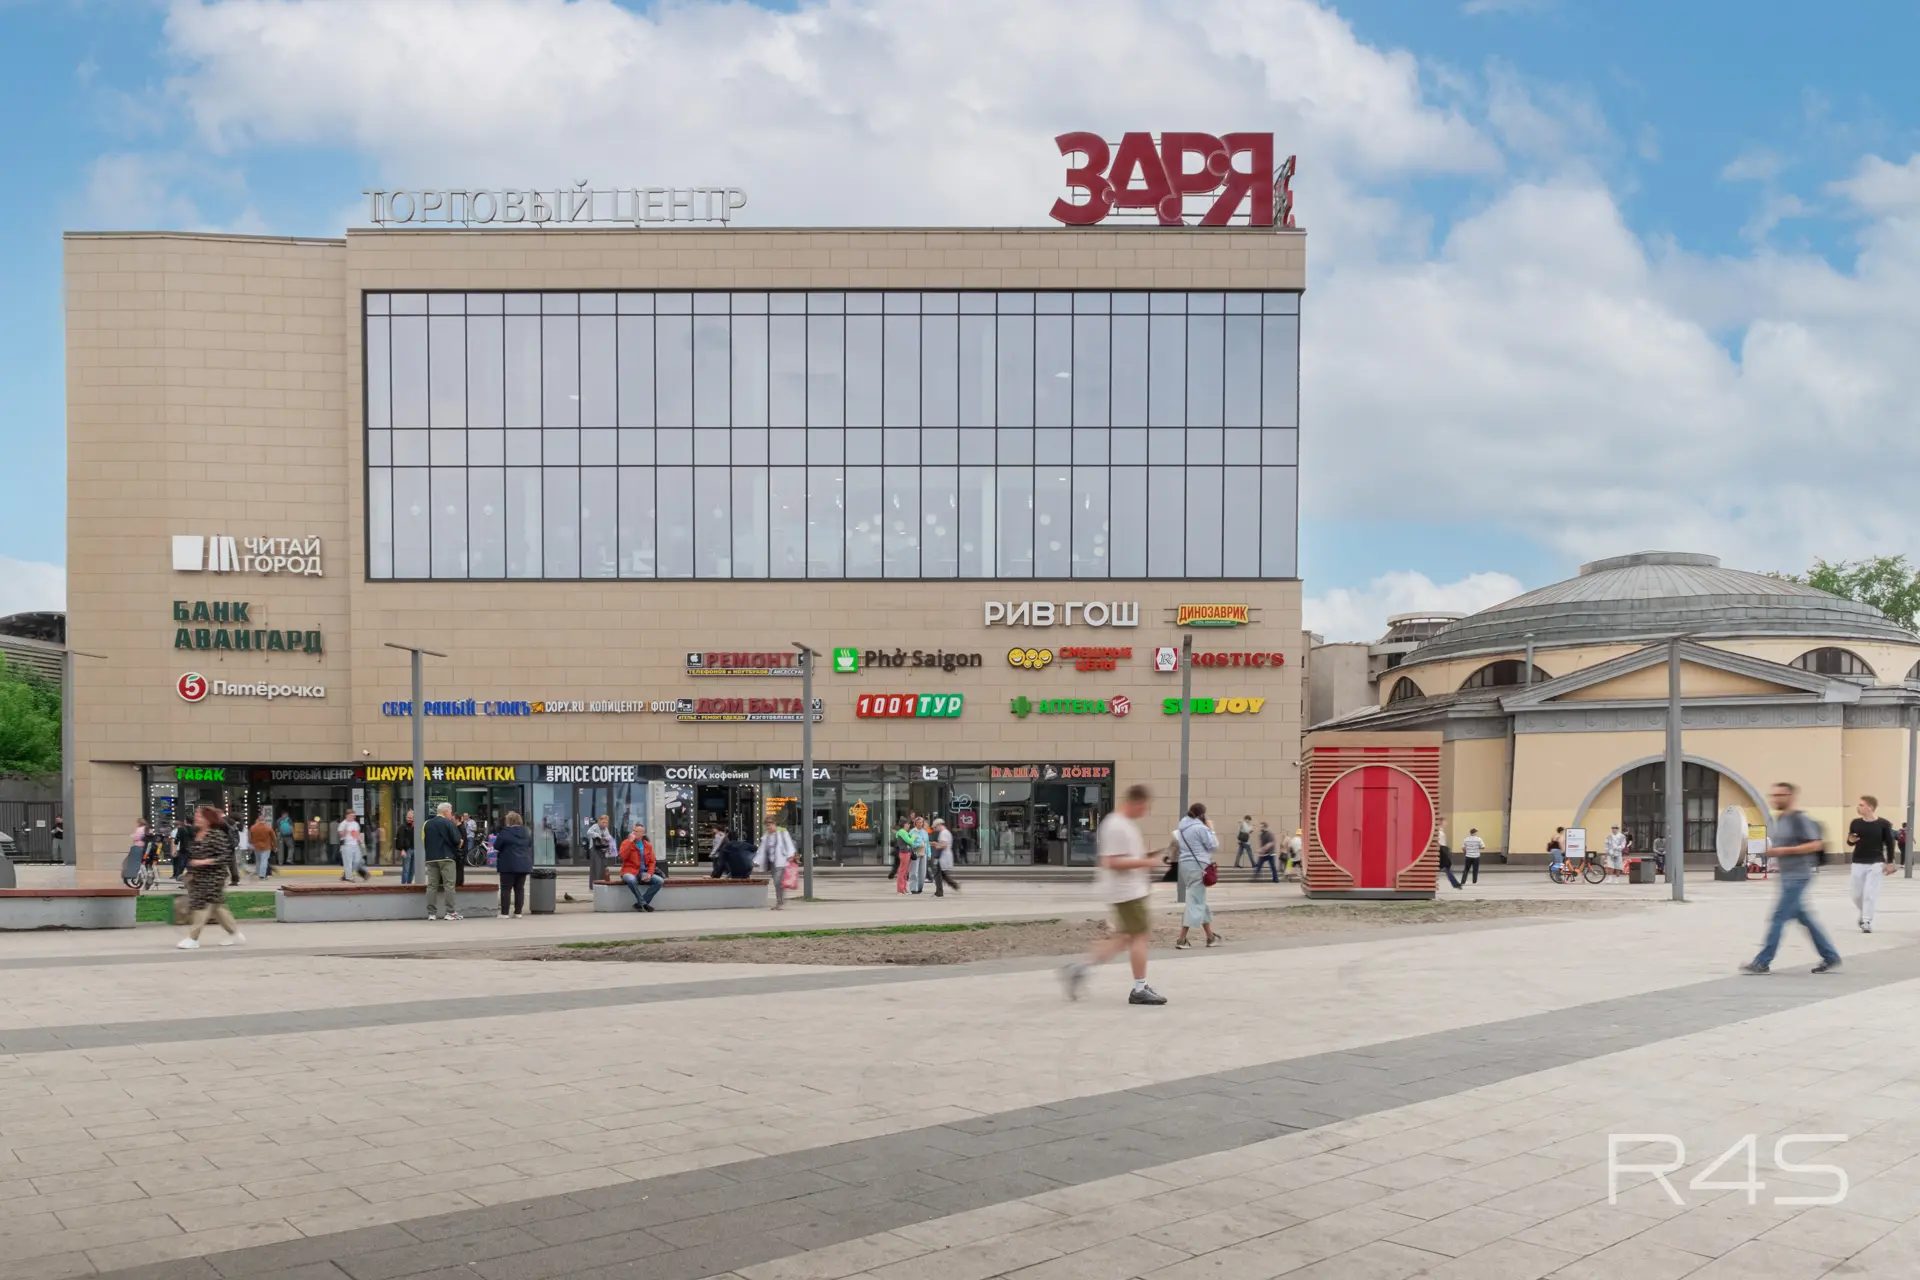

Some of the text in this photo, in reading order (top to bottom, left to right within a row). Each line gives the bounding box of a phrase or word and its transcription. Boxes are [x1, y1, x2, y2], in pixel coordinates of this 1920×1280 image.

[1049, 132, 1274, 226] ЗАРЯ
[362, 179, 747, 227] ТОРГОВЫЙ ЦЕНТР
[244, 535, 321, 555] ЧИТАЙ
[244, 555, 323, 576] ГОРОД
[173, 600, 250, 622] БАНК
[984, 601, 1139, 626] РИВ ГОШ
[1179, 605, 1247, 622] ДИНОЗАВРИК
[174, 628, 323, 654] АВАНГАРД
[706, 652, 797, 668] РЕМОНТ
[912, 650, 982, 672] Saigon
[1059, 646, 1132, 659] СМЕШНЫЕ
[1191, 652, 1285, 667] ROSTIC'S
[1075, 660, 1117, 673] ЦЕНЫ
[213, 680, 325, 699] Пятёрочка
[382, 698, 476, 716] СЕРЕРЯНЫЙ
[545, 700, 676, 713] COPY.RU КОПИЦЕНТР ФОТО
[696, 697, 804, 714] ДОМ БЫТА
[1038, 699, 1107, 714] АПТЕКА
[175, 767, 225, 781] ТАБАК
[271, 768, 354, 780] ТОРГОВЫЙ ЦЕНТР
[546, 765, 635, 782] ONE PRICE COFFEE
[666, 765, 749, 781] cofix кофейня
[770, 768, 830, 779] MET EA
[991, 767, 1040, 778] ПАША
